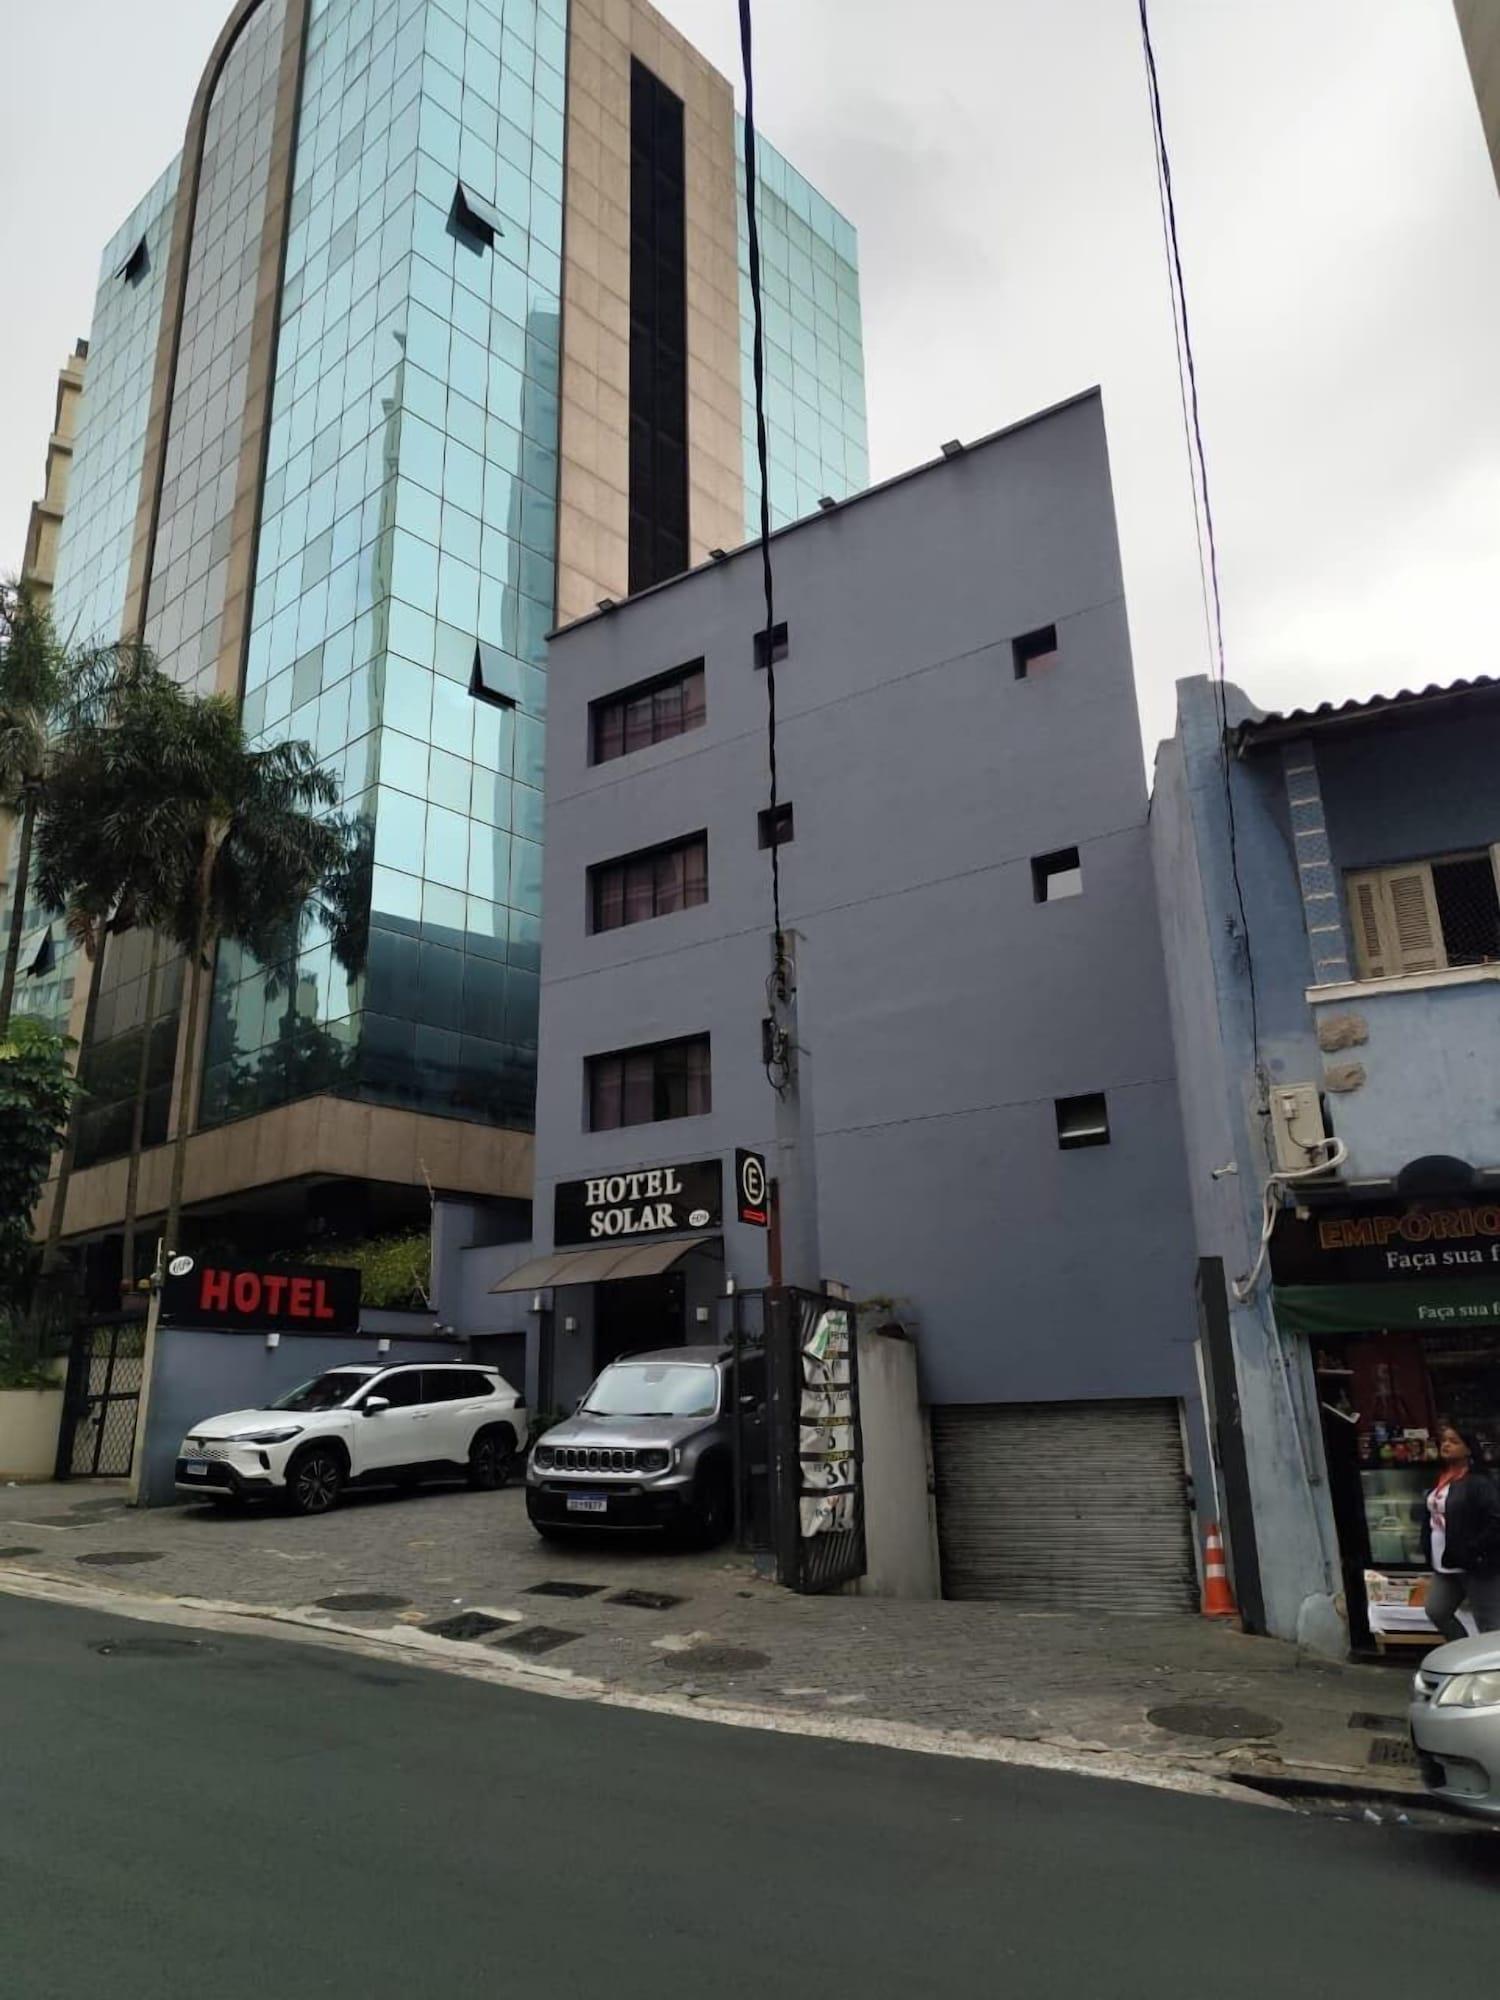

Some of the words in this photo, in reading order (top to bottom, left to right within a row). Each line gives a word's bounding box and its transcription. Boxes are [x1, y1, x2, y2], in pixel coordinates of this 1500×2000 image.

[585, 1168, 682, 1206] HOTEL
[590, 1203, 677, 1237] SOLAR
[1319, 1205, 1500, 1249] EMPÓRIO
[1386, 1251, 1436, 1271] Faça
[1442, 1250, 1484, 1265] sua
[201, 1269, 334, 1317] HOTEL
[1418, 1305, 1455, 1321] Faça
[1459, 1305, 1489, 1317] sua
